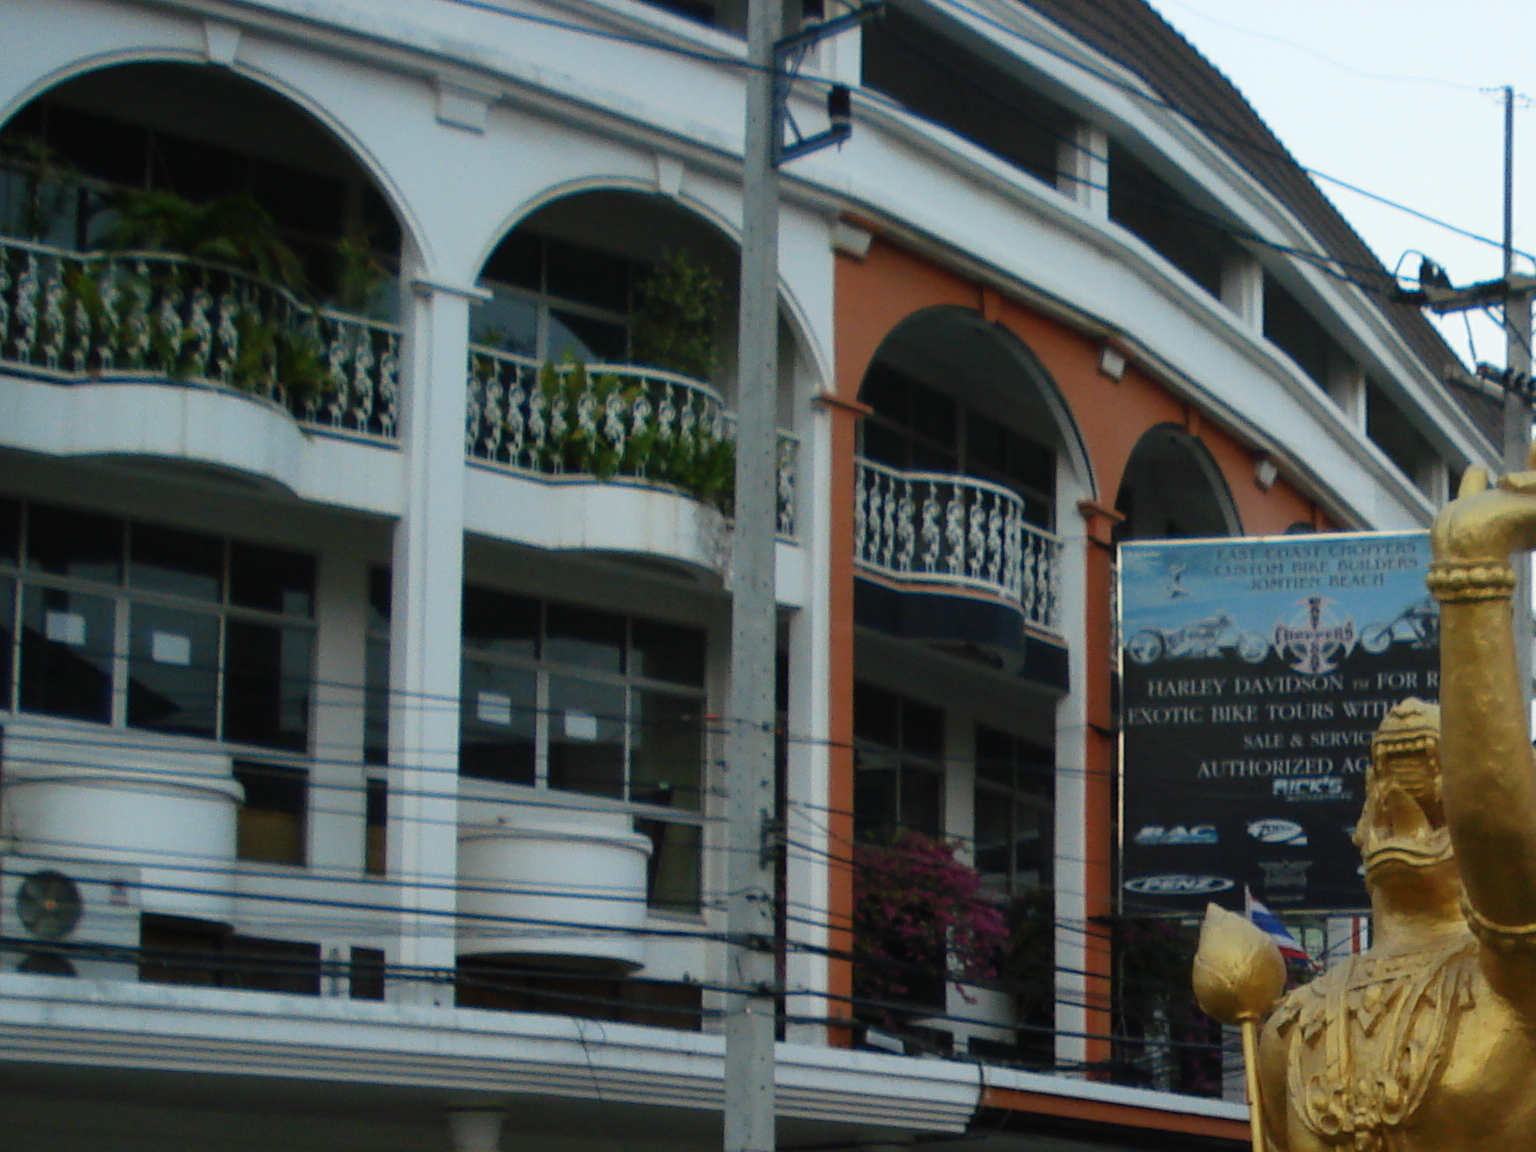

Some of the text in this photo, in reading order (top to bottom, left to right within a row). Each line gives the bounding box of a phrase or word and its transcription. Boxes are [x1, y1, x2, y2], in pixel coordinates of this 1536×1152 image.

[1265, 546, 1320, 559] COAST
[1328, 541, 1417, 557] CHOPPERS
[1214, 557, 1419, 576] CUSTOM BIKE BUILDERS
[1328, 573, 1385, 587] BEACH
[1148, 677, 1226, 698] HARLEY
[1234, 674, 1345, 696] DAVIDSON
[1376, 671, 1418, 690] FOR
[1127, 705, 1204, 725] EXOTIC
[1211, 703, 1258, 724] BIKE
[1268, 701, 1335, 721] TOURS
[1242, 730, 1375, 750] SALE & SERVIC
[1196, 756, 1334, 778] AUTHORIZED
